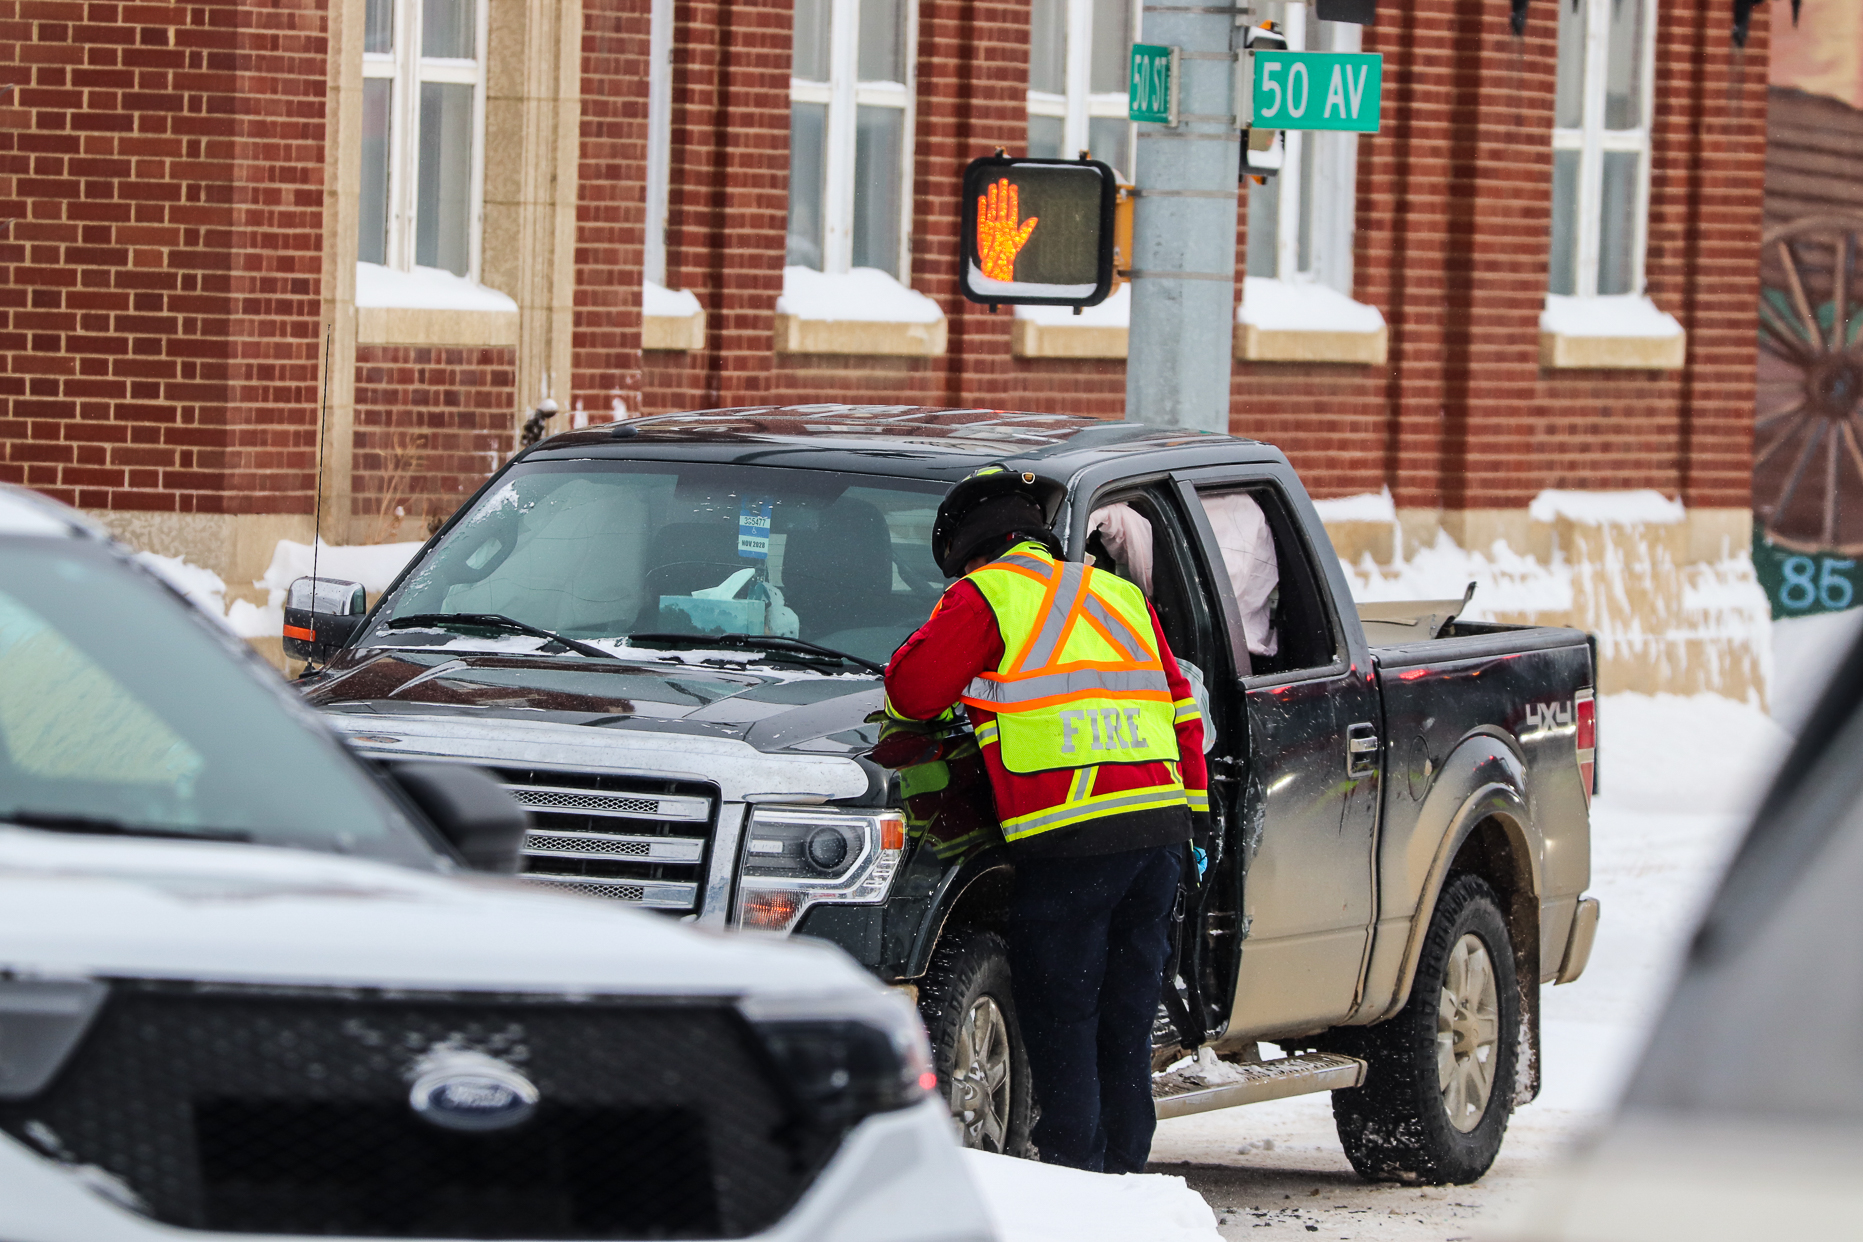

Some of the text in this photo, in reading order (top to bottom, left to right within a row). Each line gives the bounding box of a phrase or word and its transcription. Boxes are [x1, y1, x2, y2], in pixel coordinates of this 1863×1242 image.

[1133, 55, 1167, 112] 50 ST
[1261, 62, 1369, 119] 50 AV
[741, 540, 752, 548] NOV
[1060, 708, 1149, 753] FIRE
